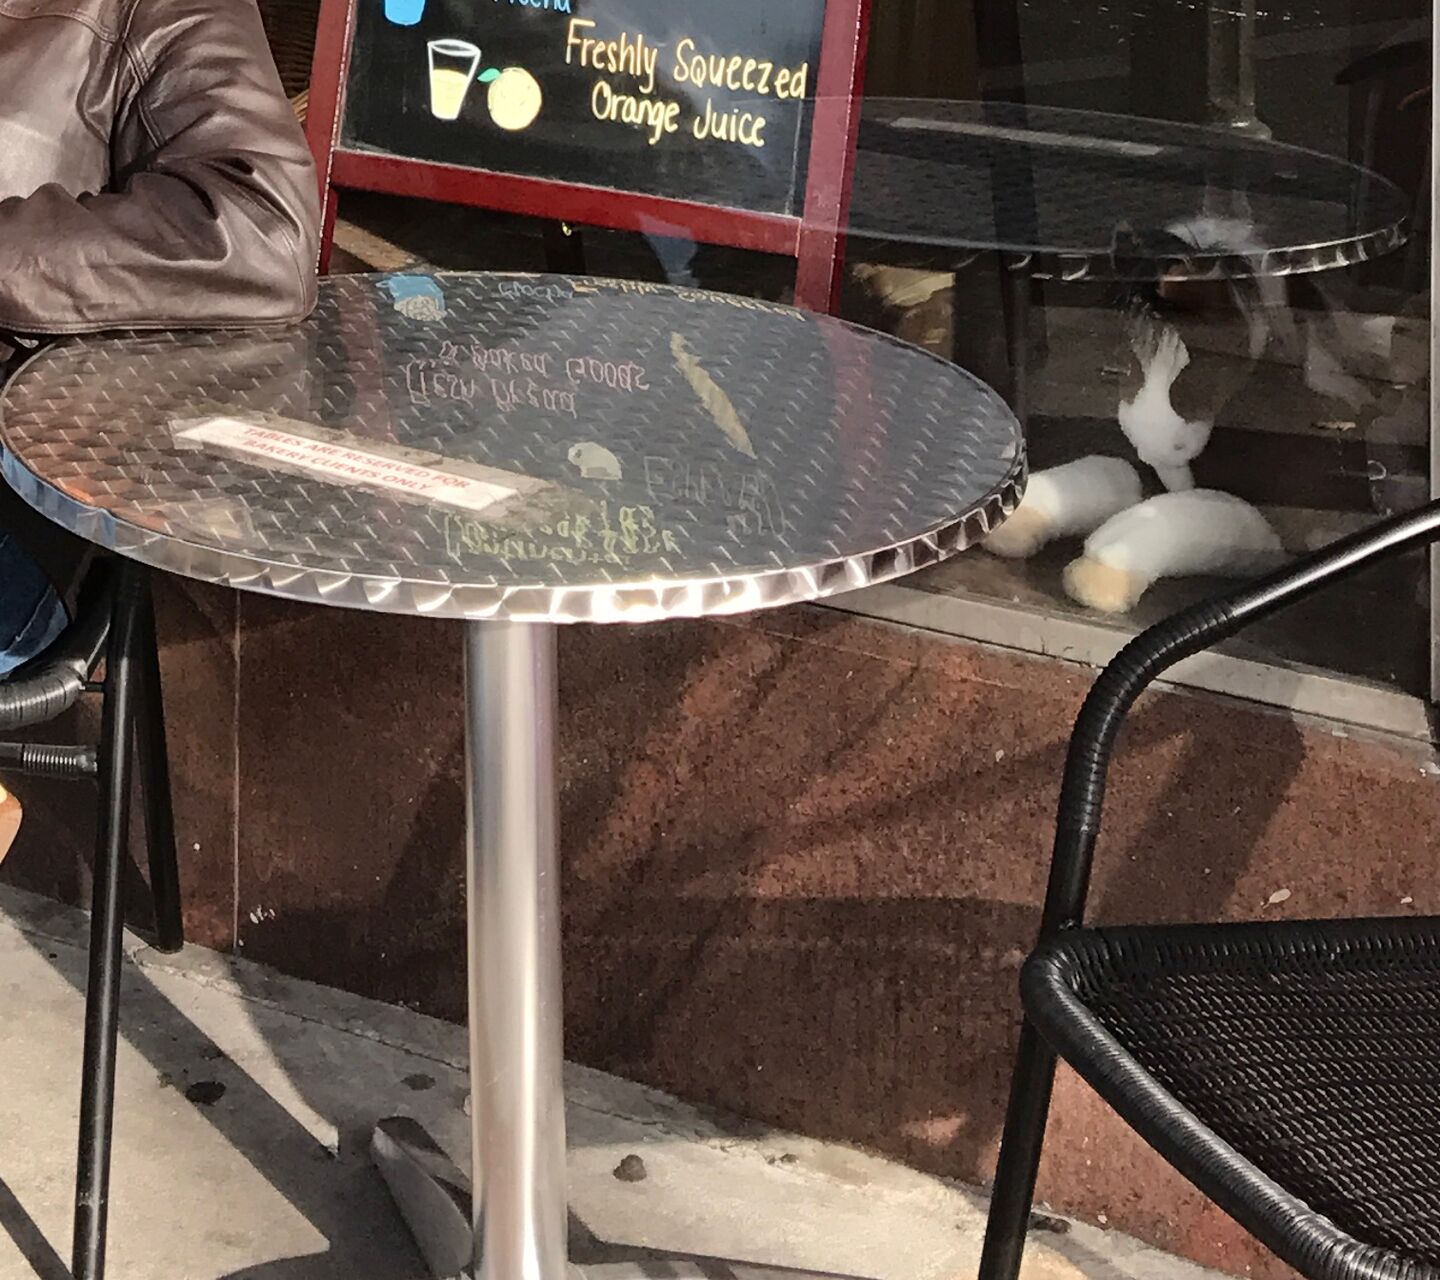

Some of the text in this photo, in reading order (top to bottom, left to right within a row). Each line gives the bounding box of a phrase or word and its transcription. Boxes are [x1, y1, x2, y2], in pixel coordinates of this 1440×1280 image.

[565, 18, 809, 100] Freshly Squeezed
[591, 80, 766, 147] Orange Juice
[244, 427, 471, 490] TABLES ARE RESERVED FOR
[247, 439, 432, 492] BAKERY CLIENTS ONLY
